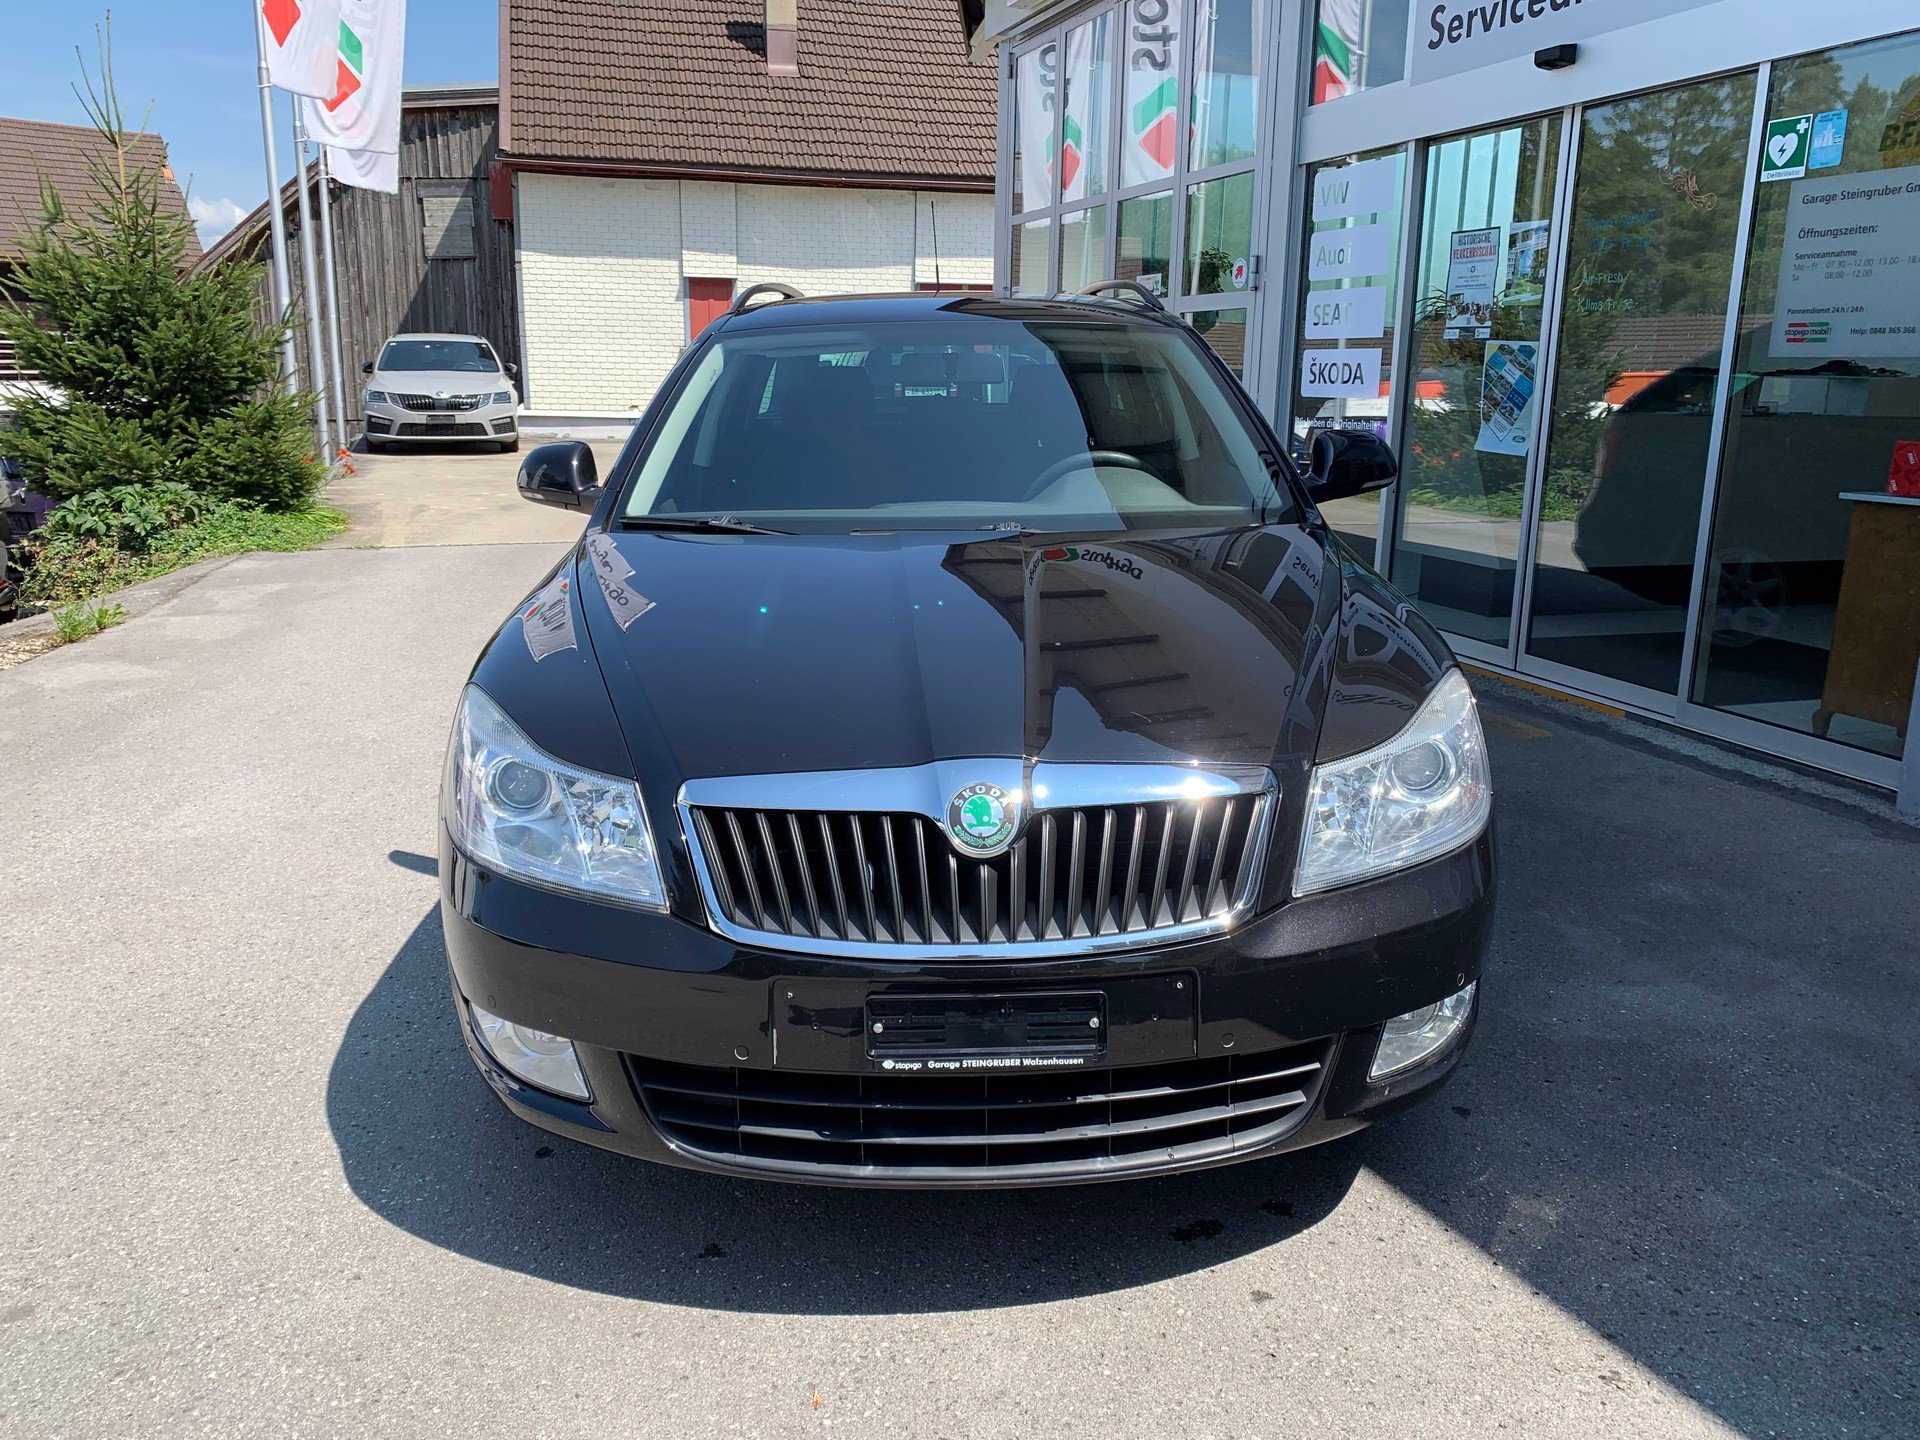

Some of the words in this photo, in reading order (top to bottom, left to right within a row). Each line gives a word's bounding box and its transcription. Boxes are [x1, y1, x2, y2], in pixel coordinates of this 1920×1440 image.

[1427, 0, 1582, 50] Service
[1321, 181, 1350, 208] VW
[1802, 193, 1838, 205] Garage
[1840, 184, 1903, 201] Steingruber
[1798, 224, 1879, 239] Öffnungszeiten:
[1795, 249, 1858, 261] Serviceannahme
[1787, 307, 1830, 315] Pannendienst
[927, 1060, 960, 1069] Garage
[962, 1058, 1021, 1068] STEINGRUBER
[1022, 1057, 1084, 1067] Walzenhausen
